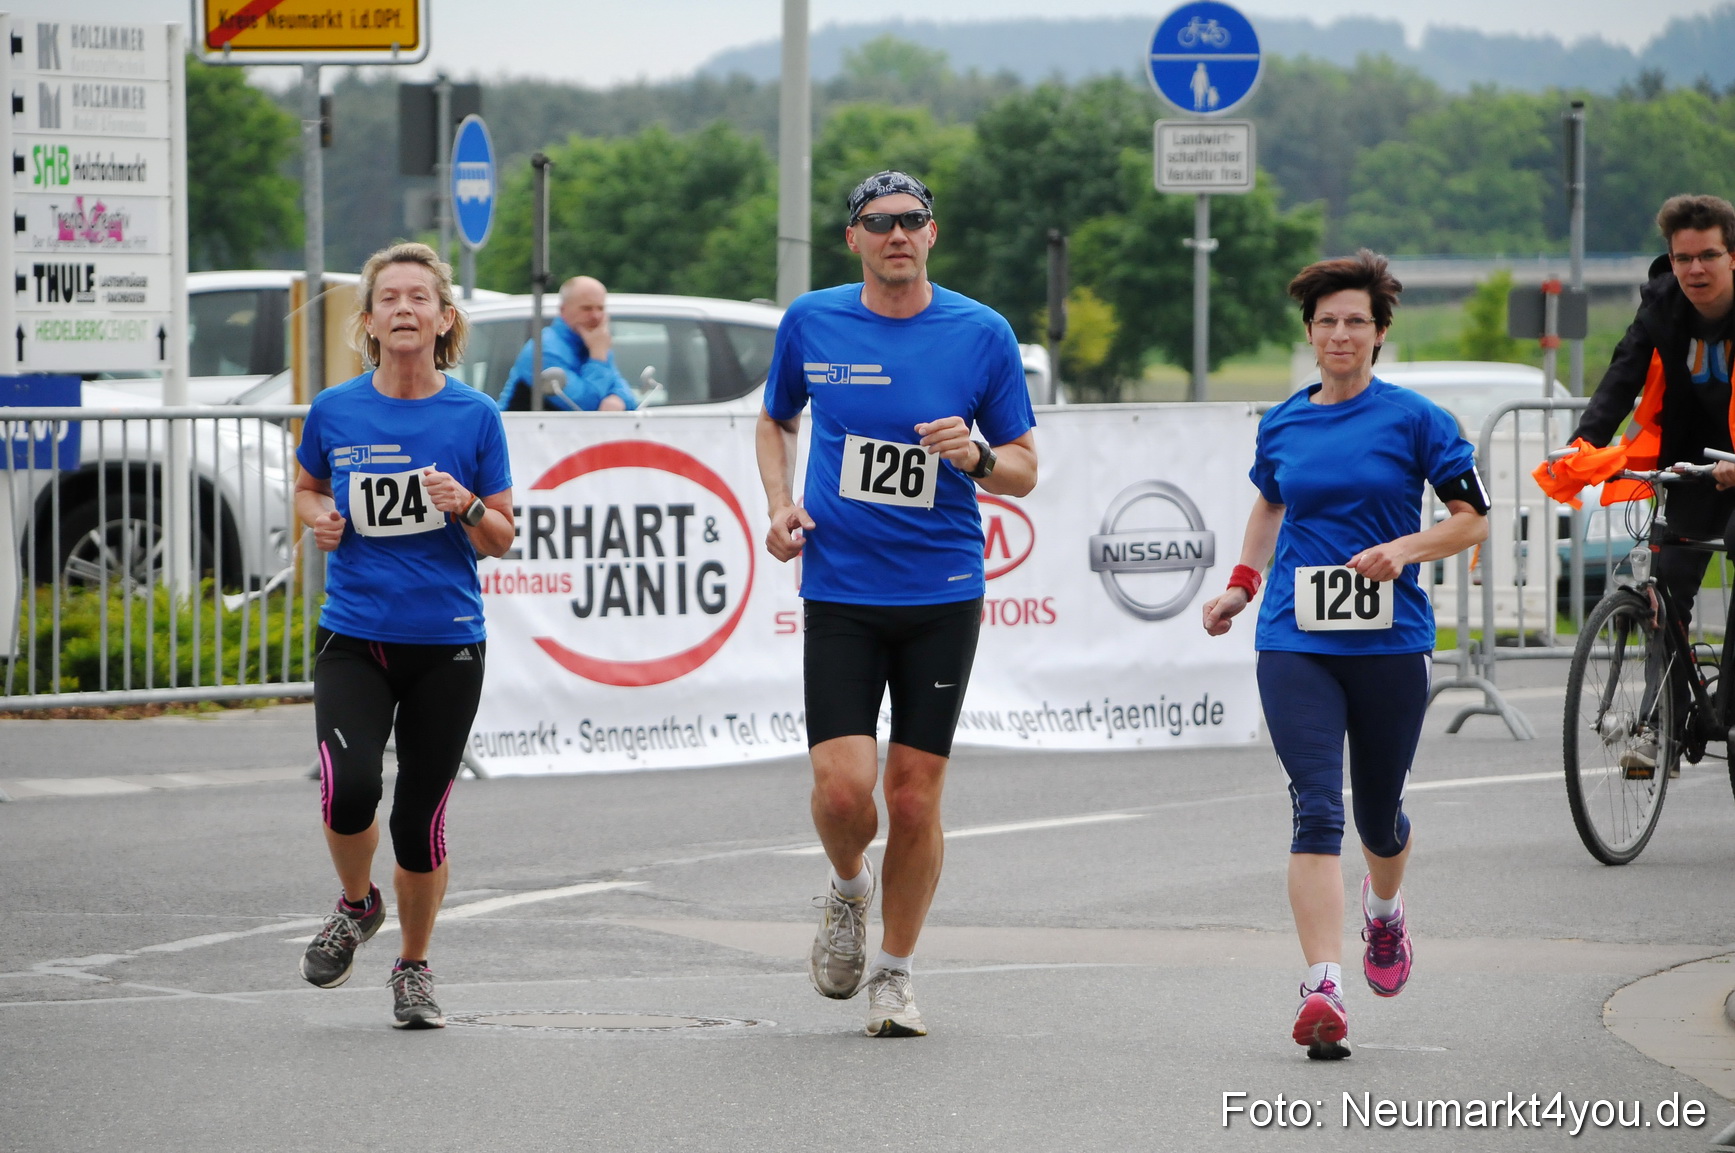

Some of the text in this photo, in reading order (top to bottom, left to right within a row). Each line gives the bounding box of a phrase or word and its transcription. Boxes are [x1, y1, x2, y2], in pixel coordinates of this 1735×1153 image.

[71, 24, 145, 51] HOLZAMMER
[218, 8, 258, 29] Kreis
[265, 8, 343, 29] Neumarkt
[72, 83, 146, 109] HOLZAMMER
[33, 145, 70, 187] SHB
[33, 263, 95, 303] THULE
[859, 442, 926, 498] 126
[360, 474, 427, 527] 124
[477, 502, 719, 561] ERHART &
[1102, 539, 1203, 563] NISSAN
[480, 568, 572, 594] utohaus
[571, 560, 727, 619] JÄNIG
[1310, 569, 1380, 621] 128
[470, 722, 559, 758] eumarkt
[579, 715, 707, 759] Sengenthal
[724, 713, 769, 745] Tel.
[958, 693, 1224, 739] ww.gerhart-jaenig.de
